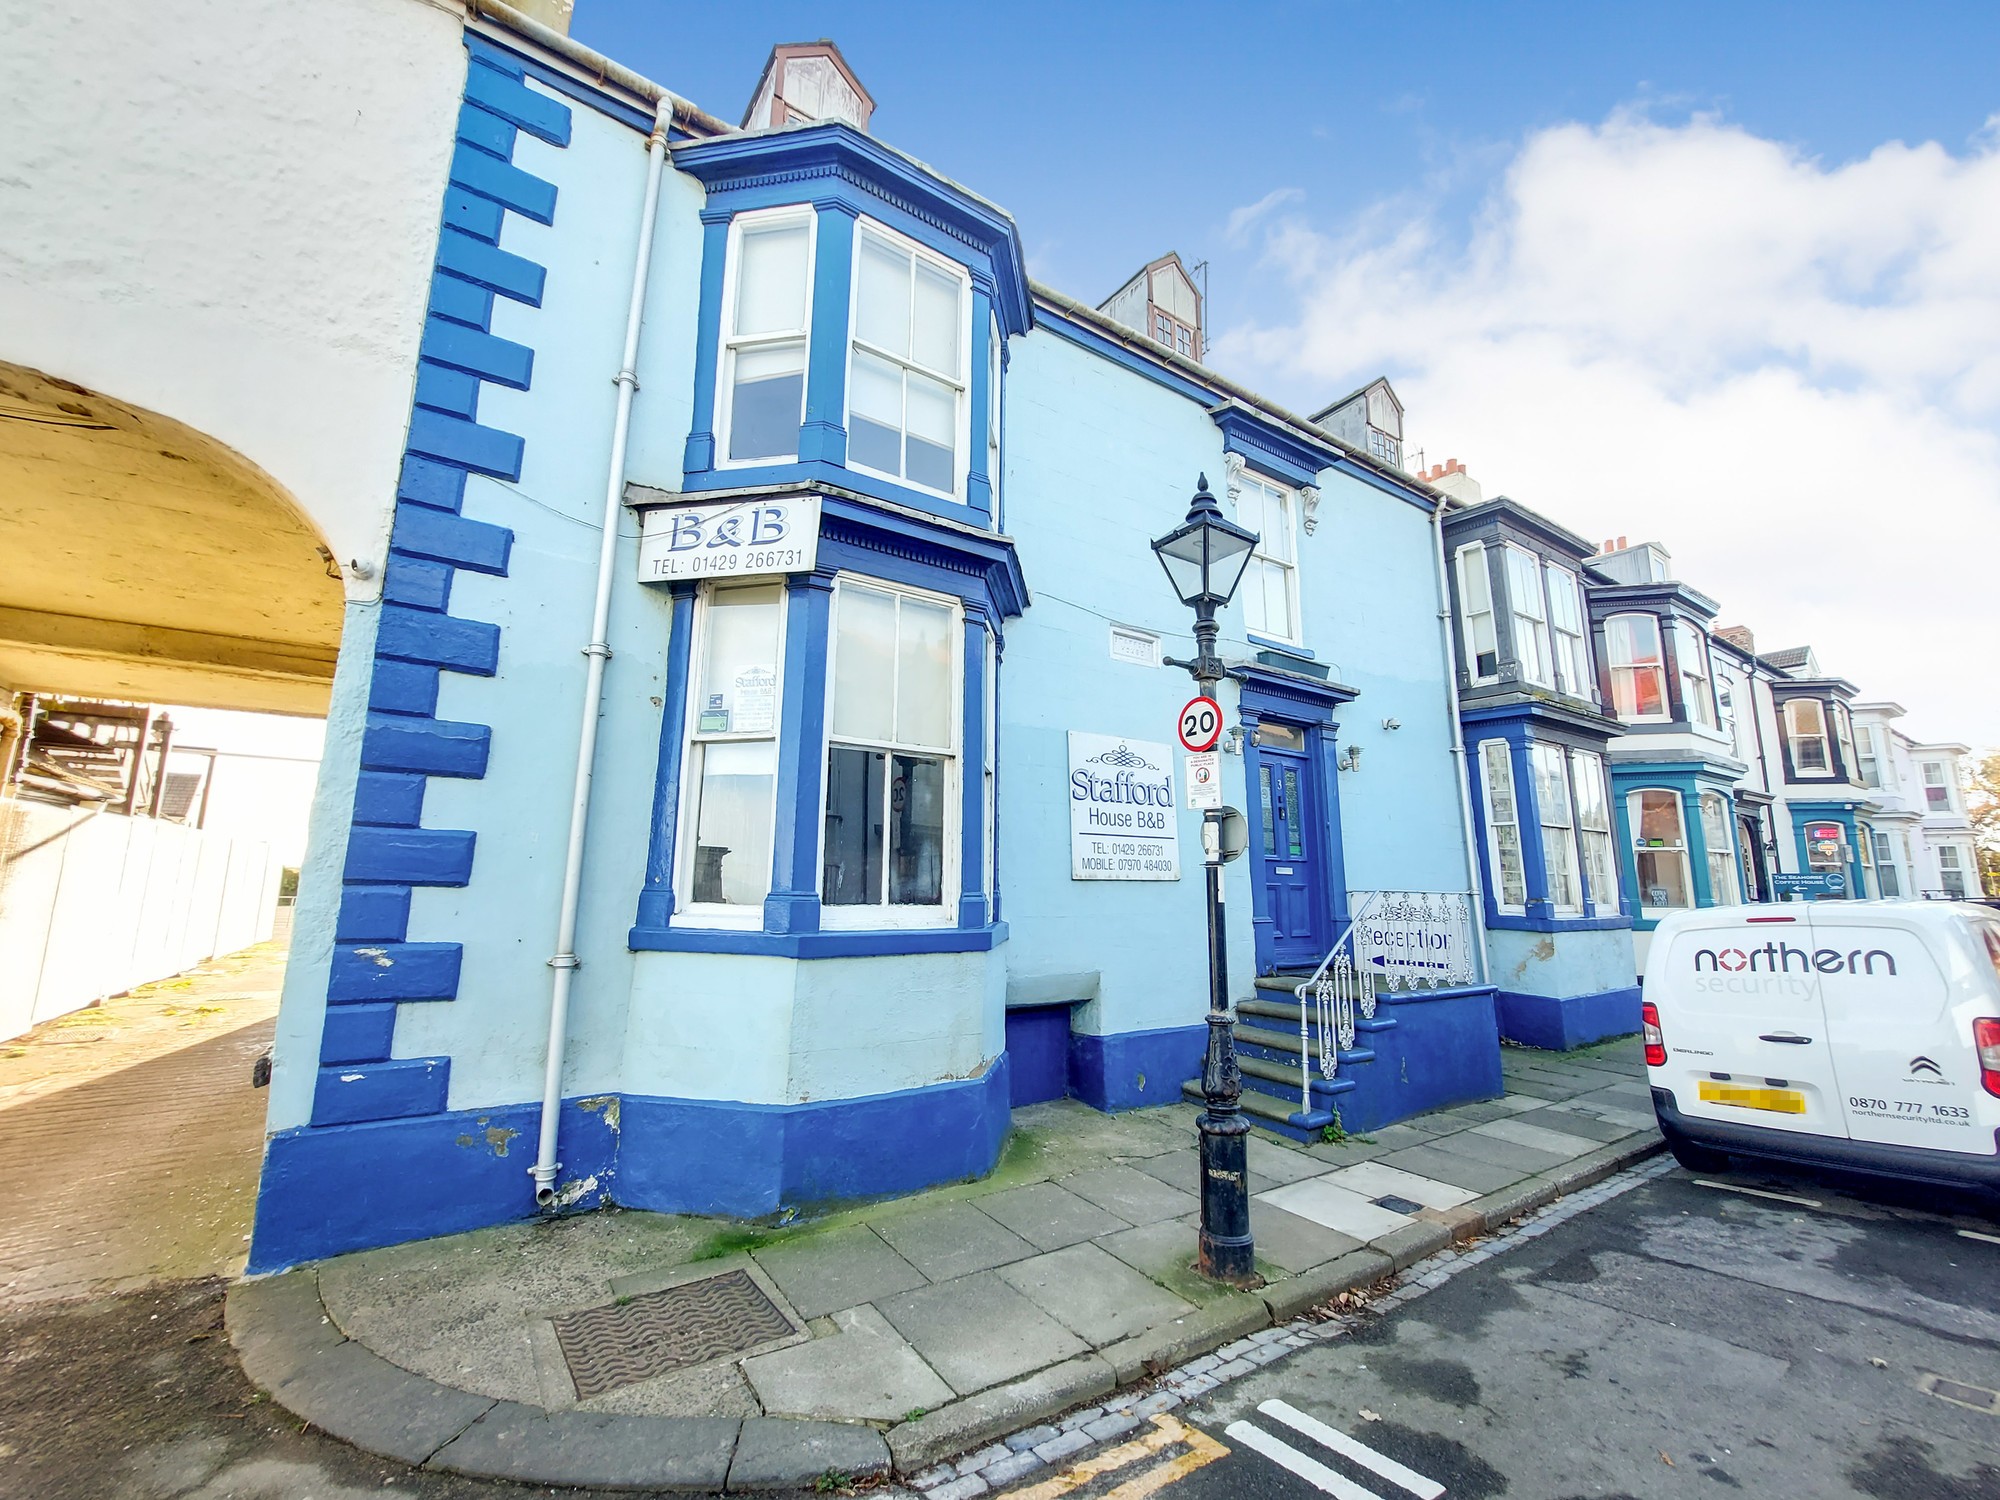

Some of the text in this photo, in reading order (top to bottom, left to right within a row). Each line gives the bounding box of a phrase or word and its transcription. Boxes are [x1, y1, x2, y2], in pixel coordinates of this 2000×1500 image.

[667, 505, 791, 552] B&B
[653, 549, 802, 575] TEL: 01429 266731
[735, 674, 777, 688] Stafford
[1185, 711, 1214, 738] 20
[1071, 768, 1174, 807] Stafford
[1277, 779, 1283, 790] 3
[1089, 807, 1165, 829] House B&B
[1092, 842, 1164, 856] TEL: 01429 266731
[1082, 857, 1172, 872] MOBILE: 07970 484030
[1694, 942, 1897, 975] northern
[1695, 975, 1817, 1001] security
[1672, 1047, 1714, 1056] BERLINGO
[1849, 1096, 1970, 1119] 0870 777 1633
[1852, 1109, 1971, 1127] northernsecurityltd.co.uk
